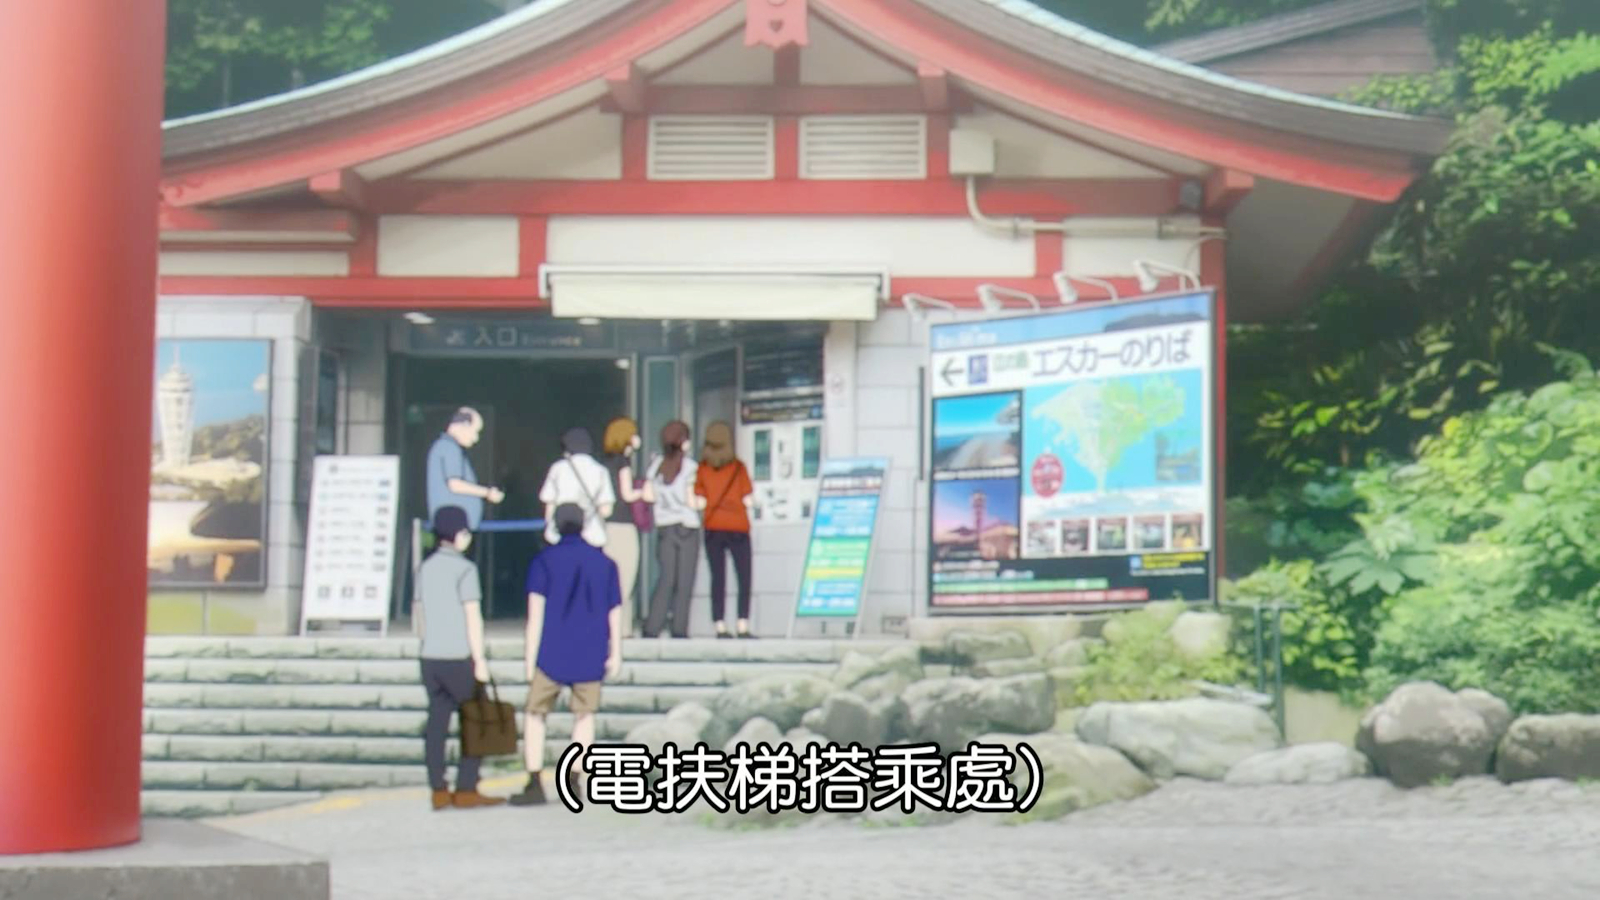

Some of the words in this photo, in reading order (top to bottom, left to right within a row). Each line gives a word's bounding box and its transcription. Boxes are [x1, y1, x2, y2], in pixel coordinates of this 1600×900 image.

[474, 327, 518, 346] 入口
[1033, 330, 1193, 376] エスカーのりば
